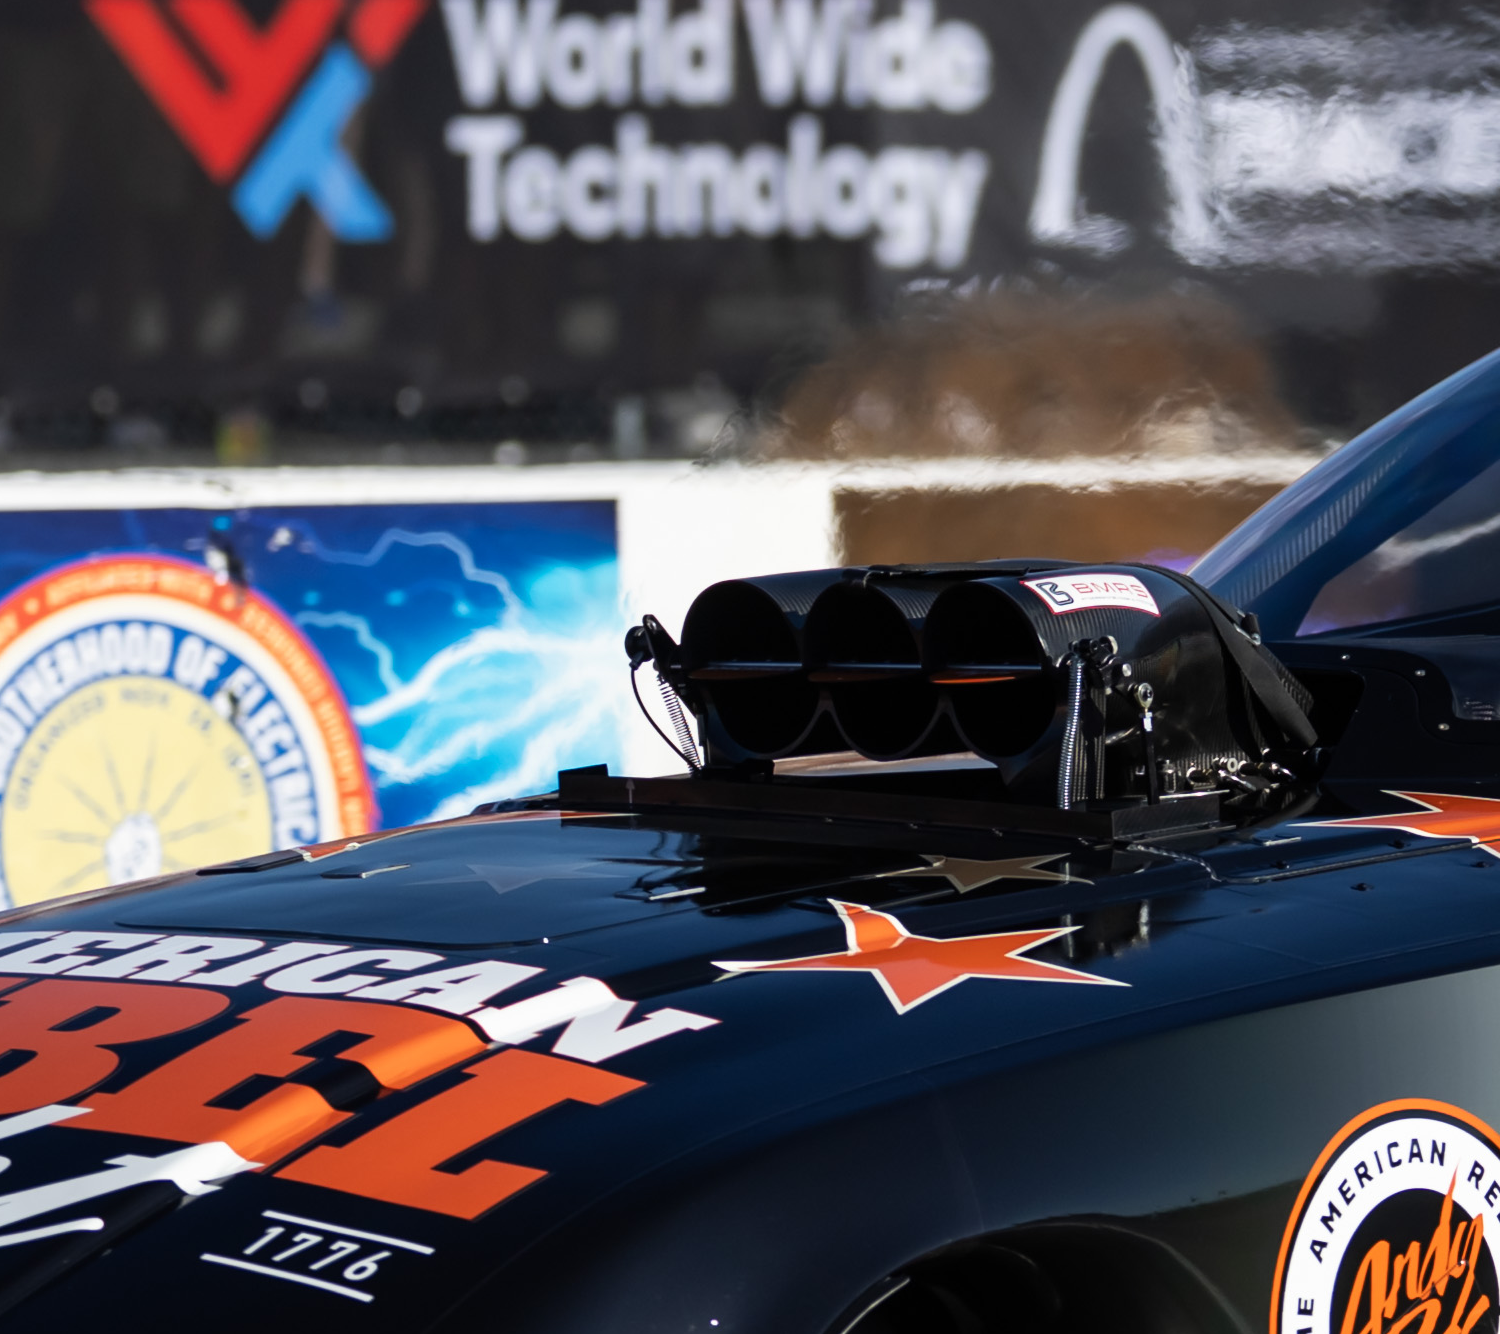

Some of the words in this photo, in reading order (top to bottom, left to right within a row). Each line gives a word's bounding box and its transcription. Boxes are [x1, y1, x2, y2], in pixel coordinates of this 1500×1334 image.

[445, 114, 990, 268] Technology
[174, 634, 230, 694] OF
[1308, 1137, 1448, 1264] AMERICAN
[240, 1225, 393, 1284] 1776
